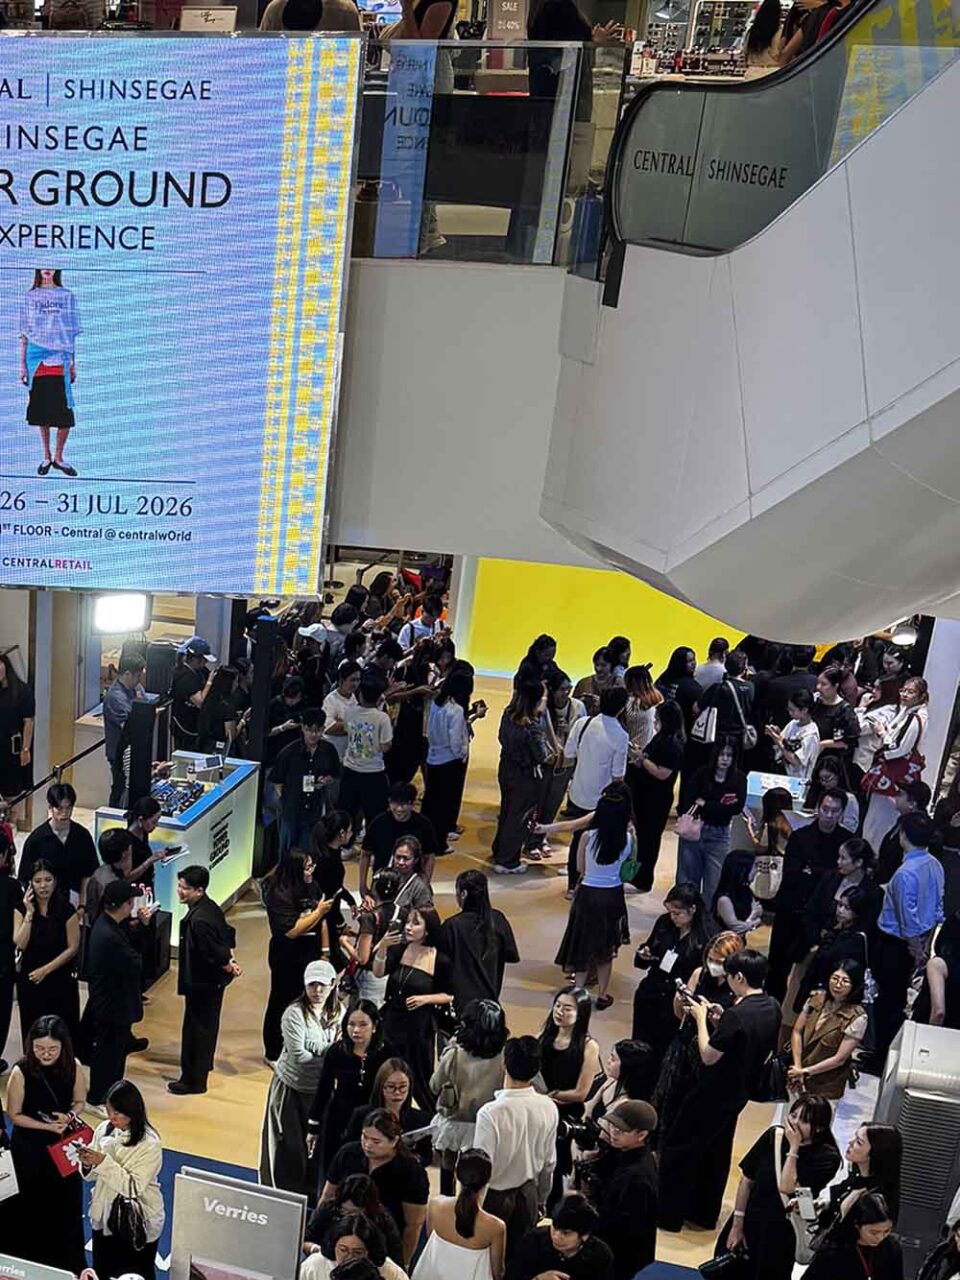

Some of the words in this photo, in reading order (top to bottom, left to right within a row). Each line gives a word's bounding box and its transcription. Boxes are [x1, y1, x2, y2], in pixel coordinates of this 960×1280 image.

[63, 79, 213, 101] SHINSEGAE
[633, 149, 695, 177] CENTRAL
[707, 158, 788, 189] SHINSEGAE
[29, 168, 232, 208] GROUND
[56, 492, 78, 514] 31
[85, 493, 128, 516] JUL
[135, 495, 194, 517] 2026
[13, 524, 52, 536] FLOOR
[61, 526, 103, 540] Central
[104, 528, 117, 541] @
[203, 1196, 269, 1225] Verries
